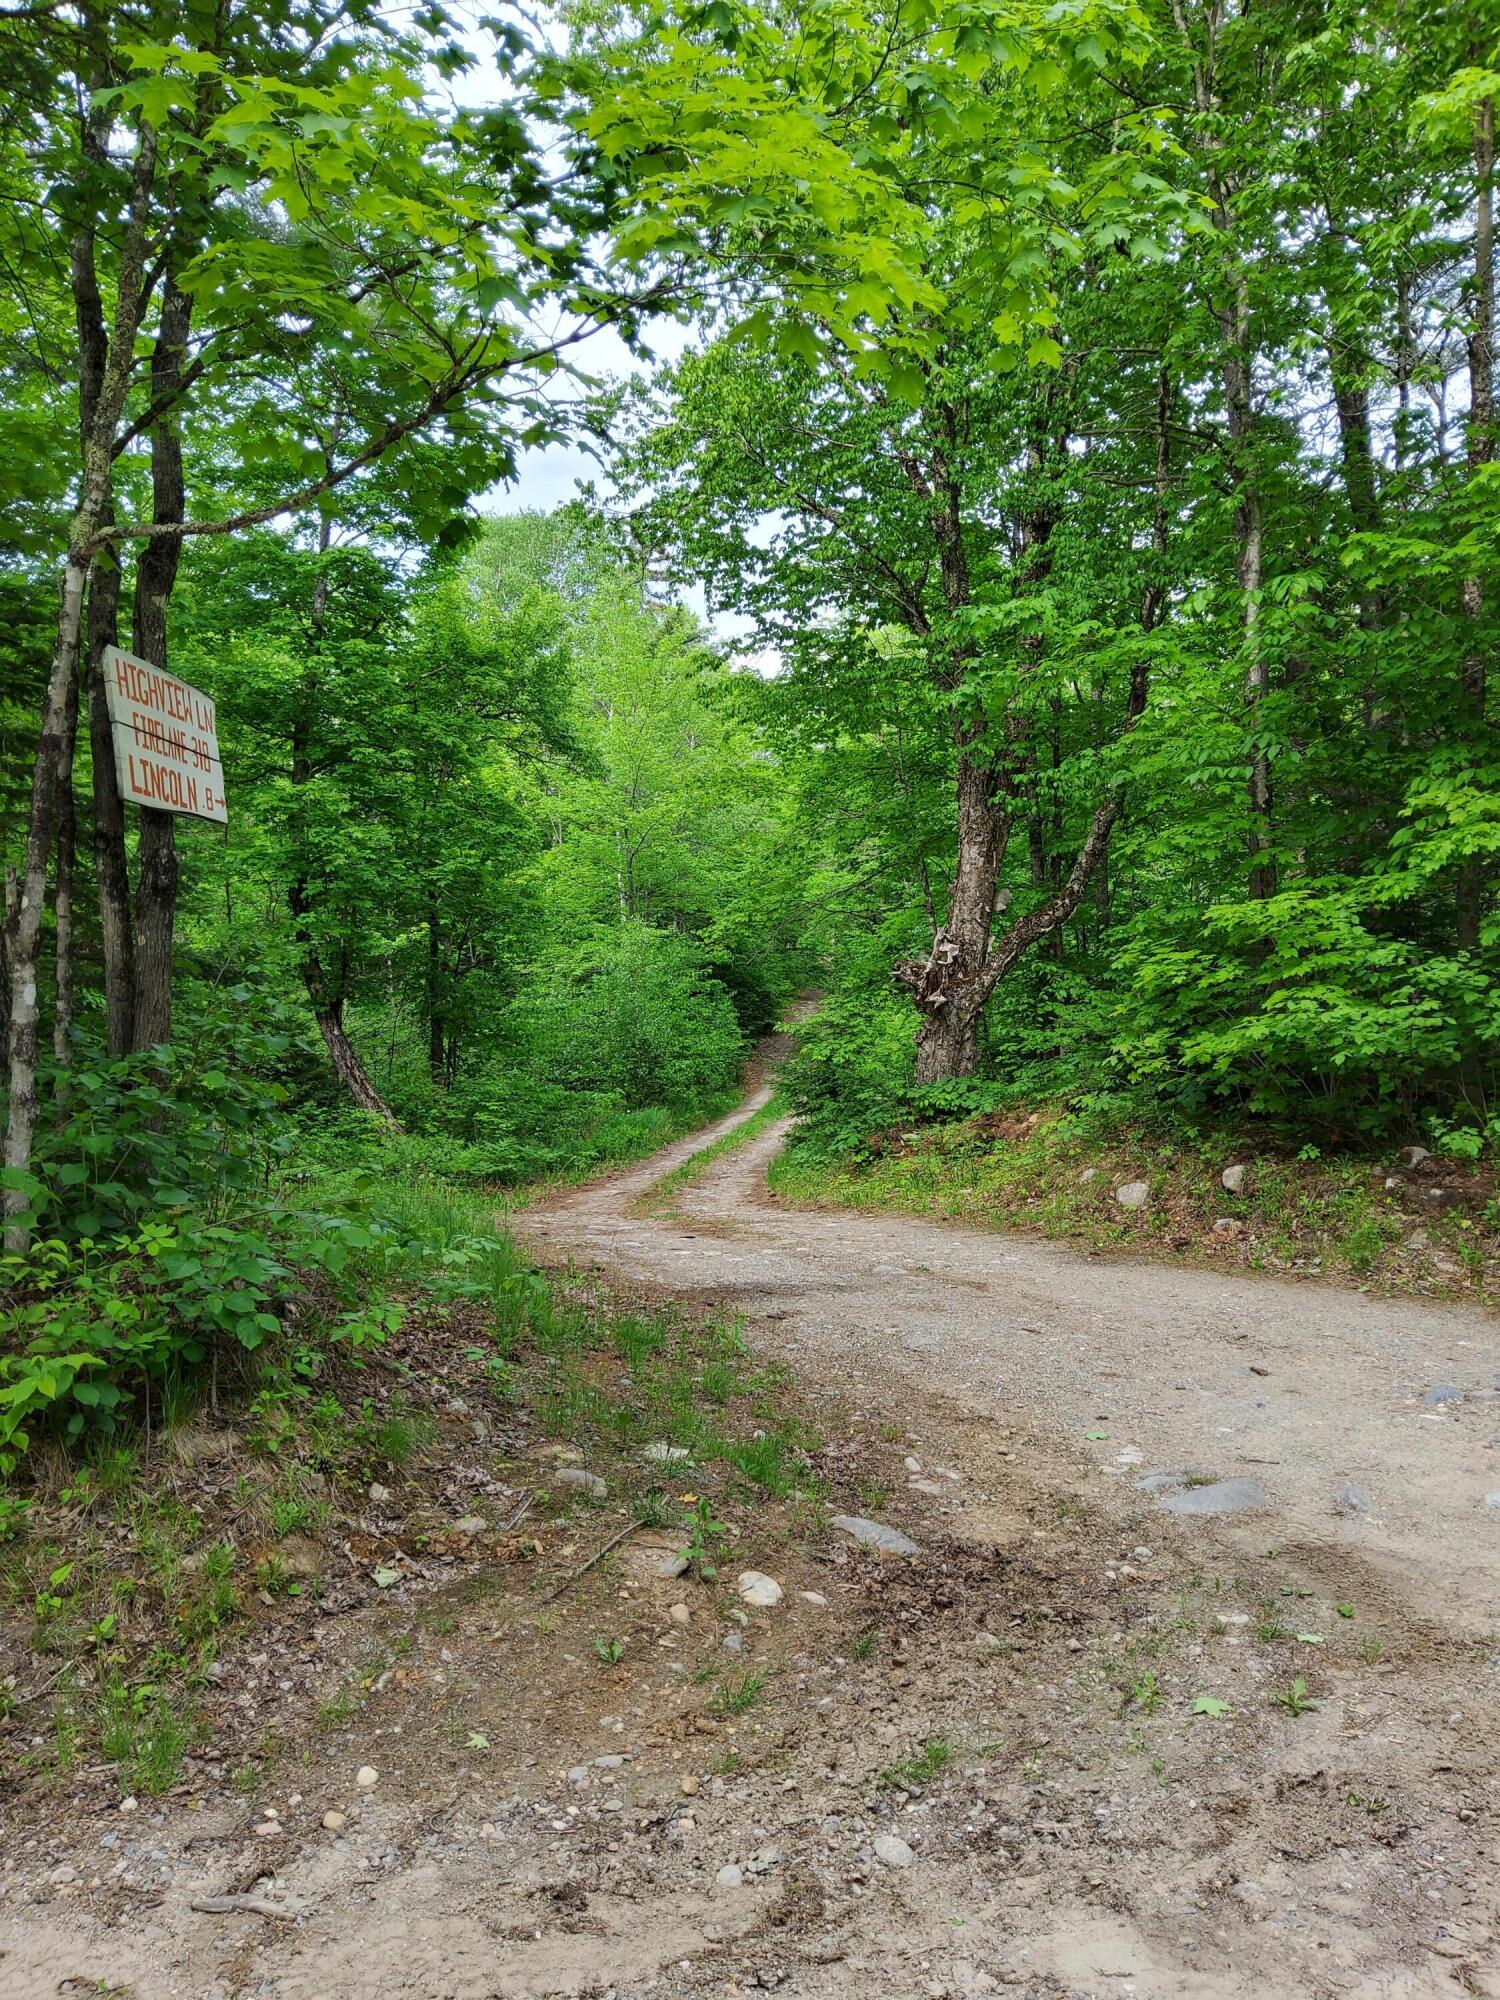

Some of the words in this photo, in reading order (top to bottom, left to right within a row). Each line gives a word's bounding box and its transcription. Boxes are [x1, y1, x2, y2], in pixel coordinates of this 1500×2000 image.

[115, 658, 193, 725] HIGHVIEW
[195, 701, 213, 734] LN
[132, 711, 188, 764] FIRELANE
[128, 754, 198, 812] LINCOLN
